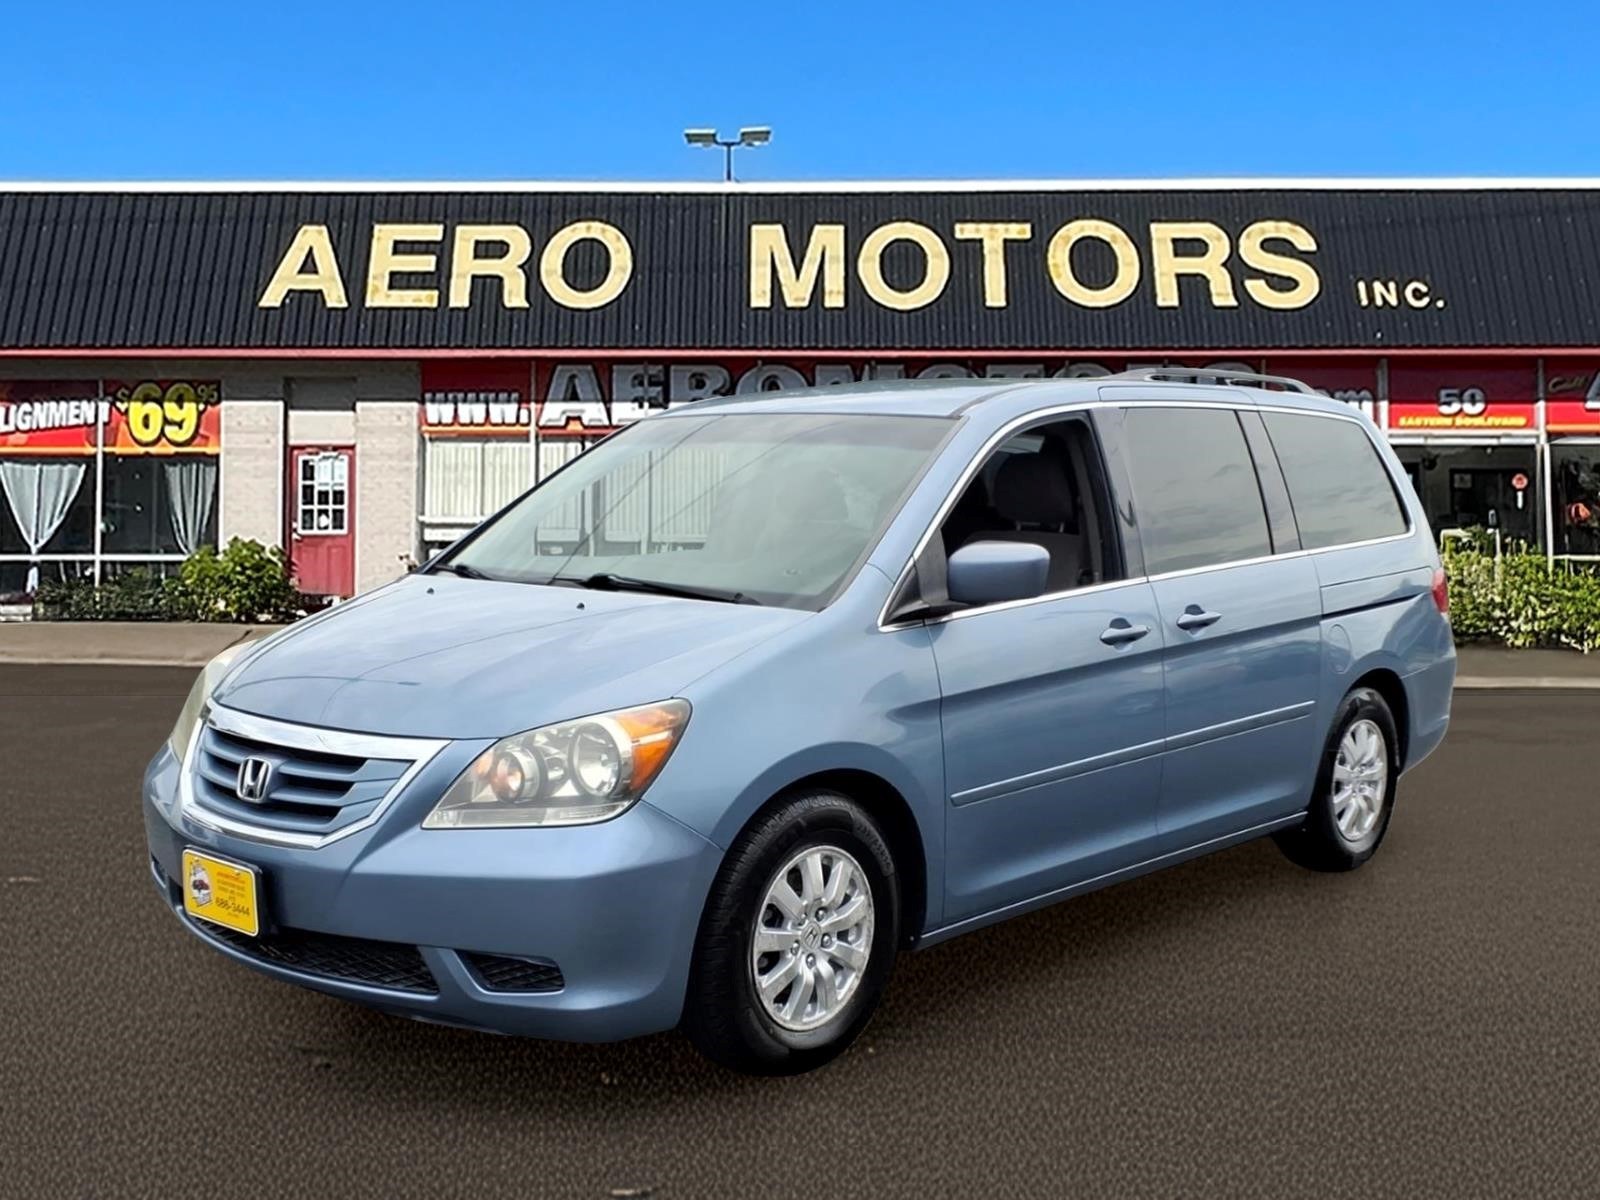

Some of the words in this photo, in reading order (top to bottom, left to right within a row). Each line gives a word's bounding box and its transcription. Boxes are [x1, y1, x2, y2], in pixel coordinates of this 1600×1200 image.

[258, 220, 633, 309] AERO
[750, 219, 1321, 310] MOTORS
[1357, 280, 1446, 308] INC.
[1438, 388, 1486, 415] 50
